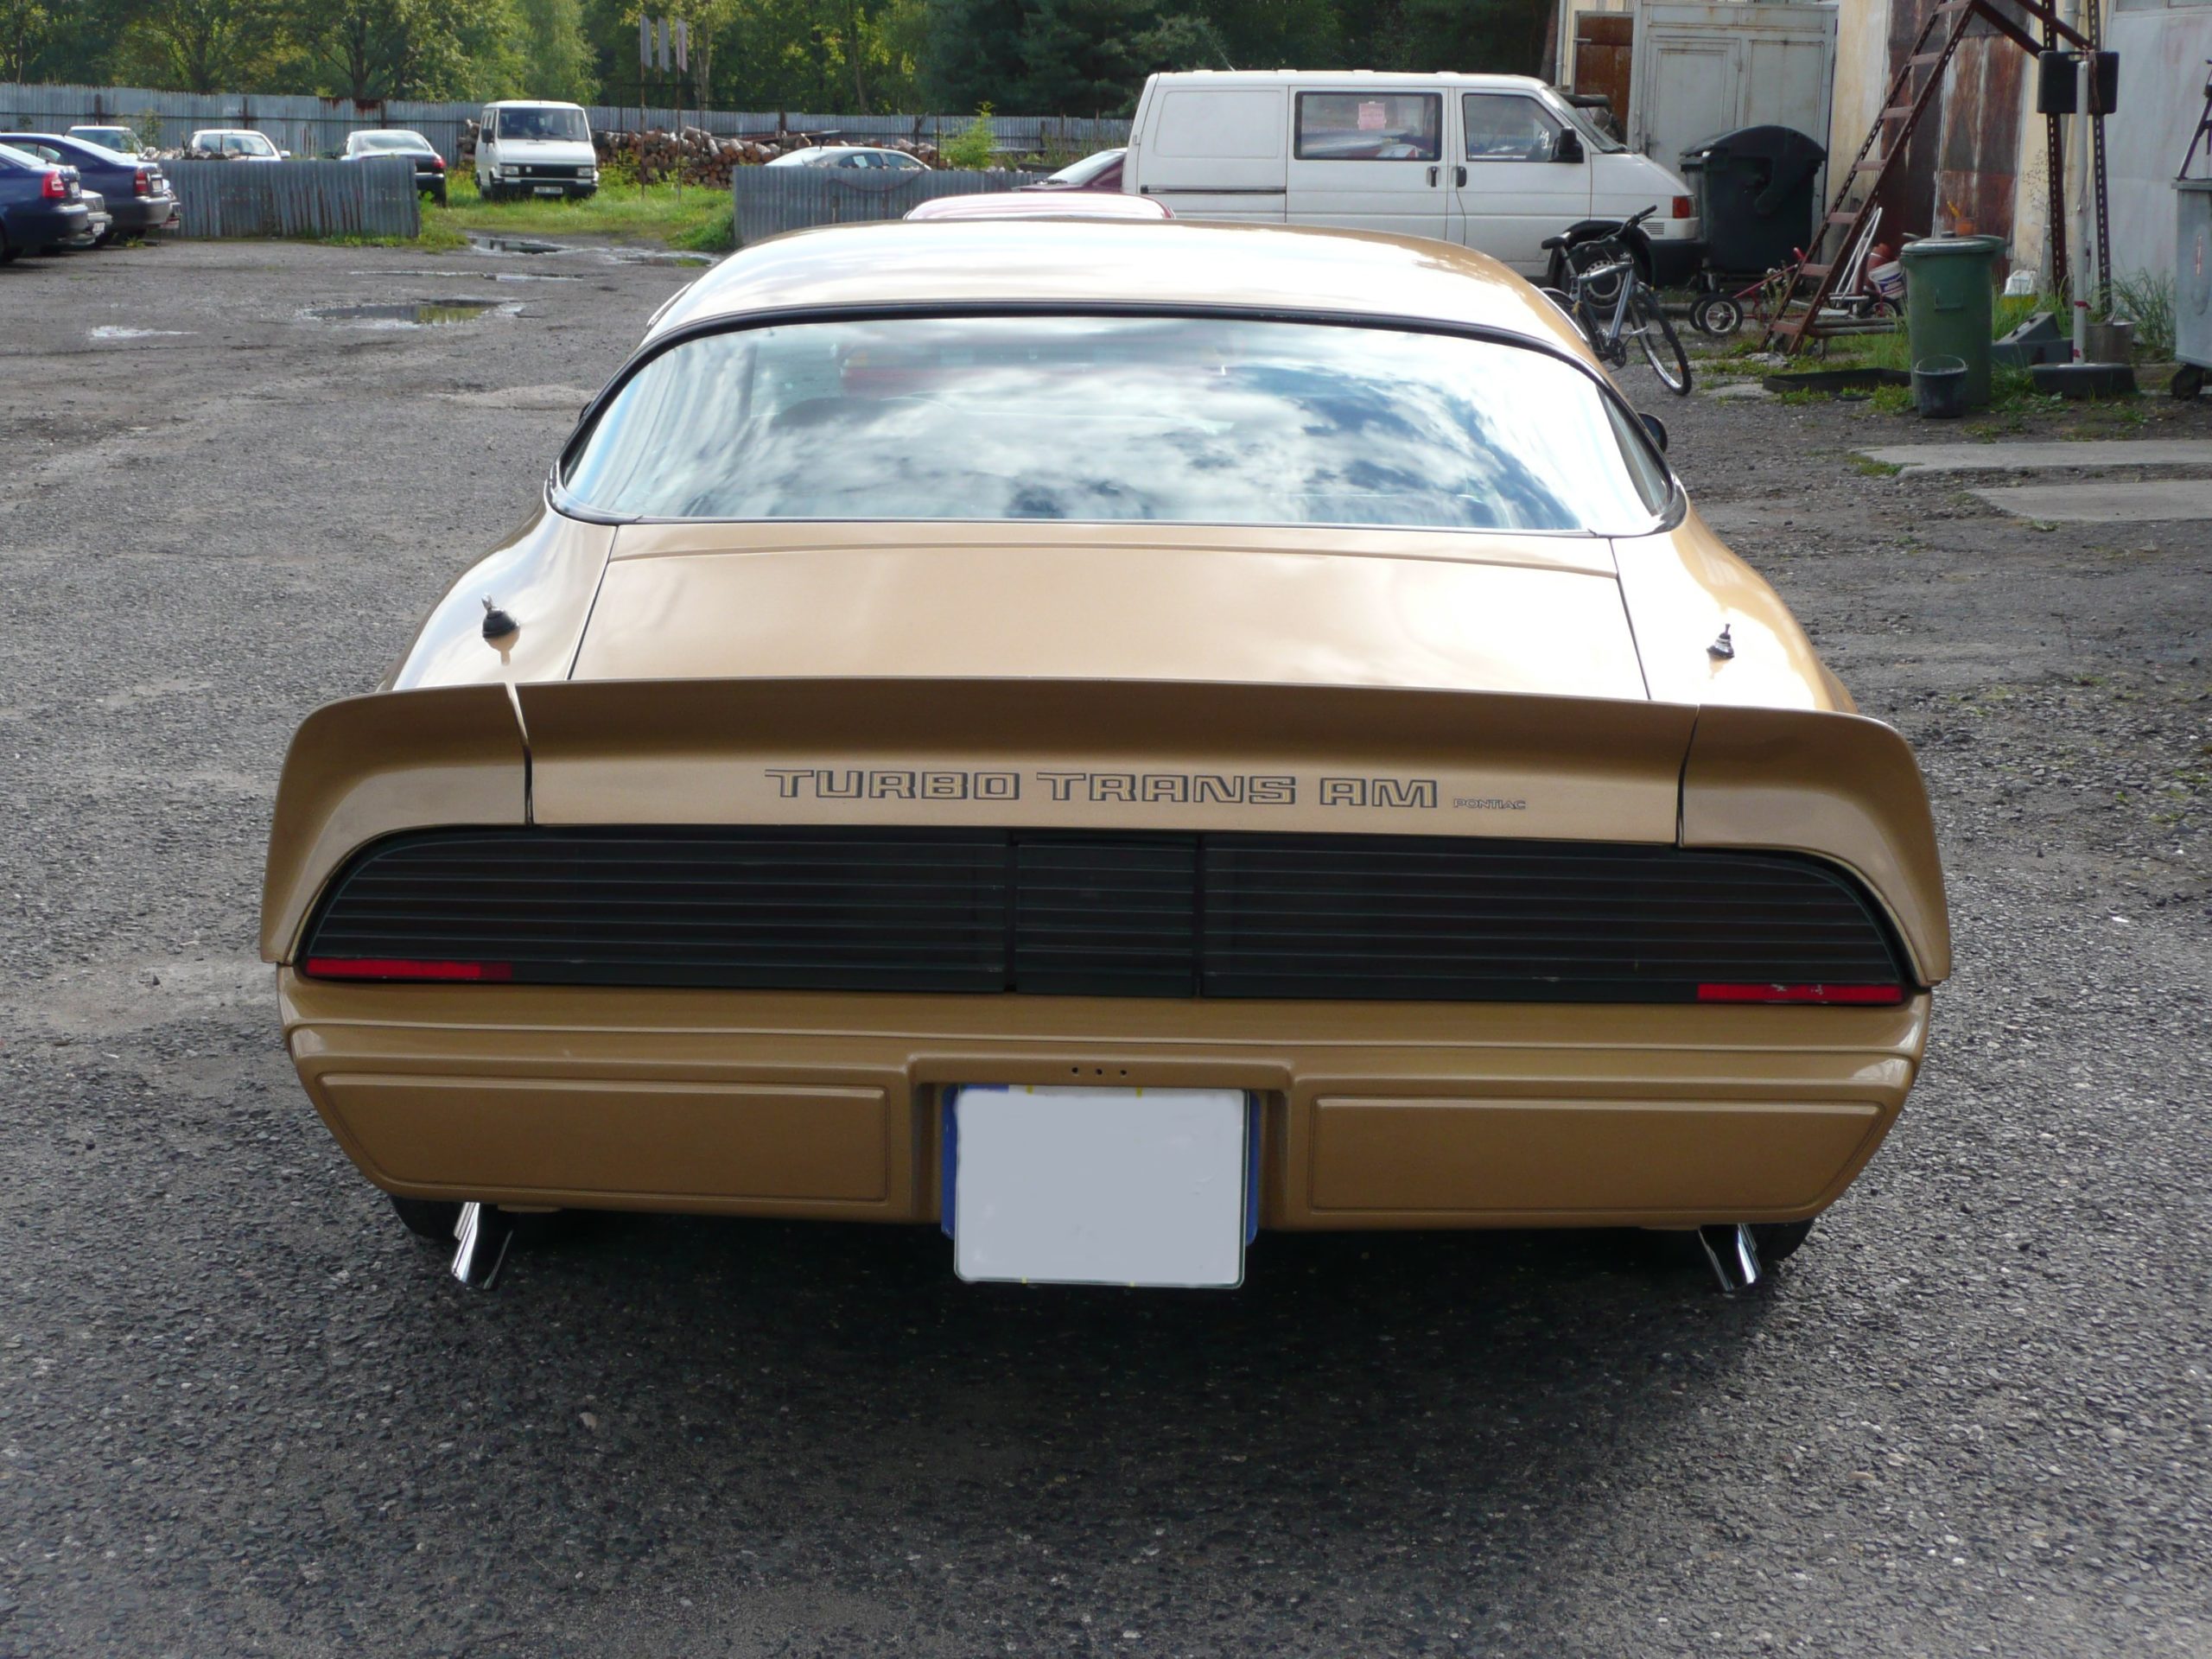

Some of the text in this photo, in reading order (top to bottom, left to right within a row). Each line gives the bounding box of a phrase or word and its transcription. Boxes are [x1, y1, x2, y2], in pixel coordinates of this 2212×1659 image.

[765, 769, 1438, 809] TURBO TRANS AM
[1453, 798, 1527, 810] PONTIAC
